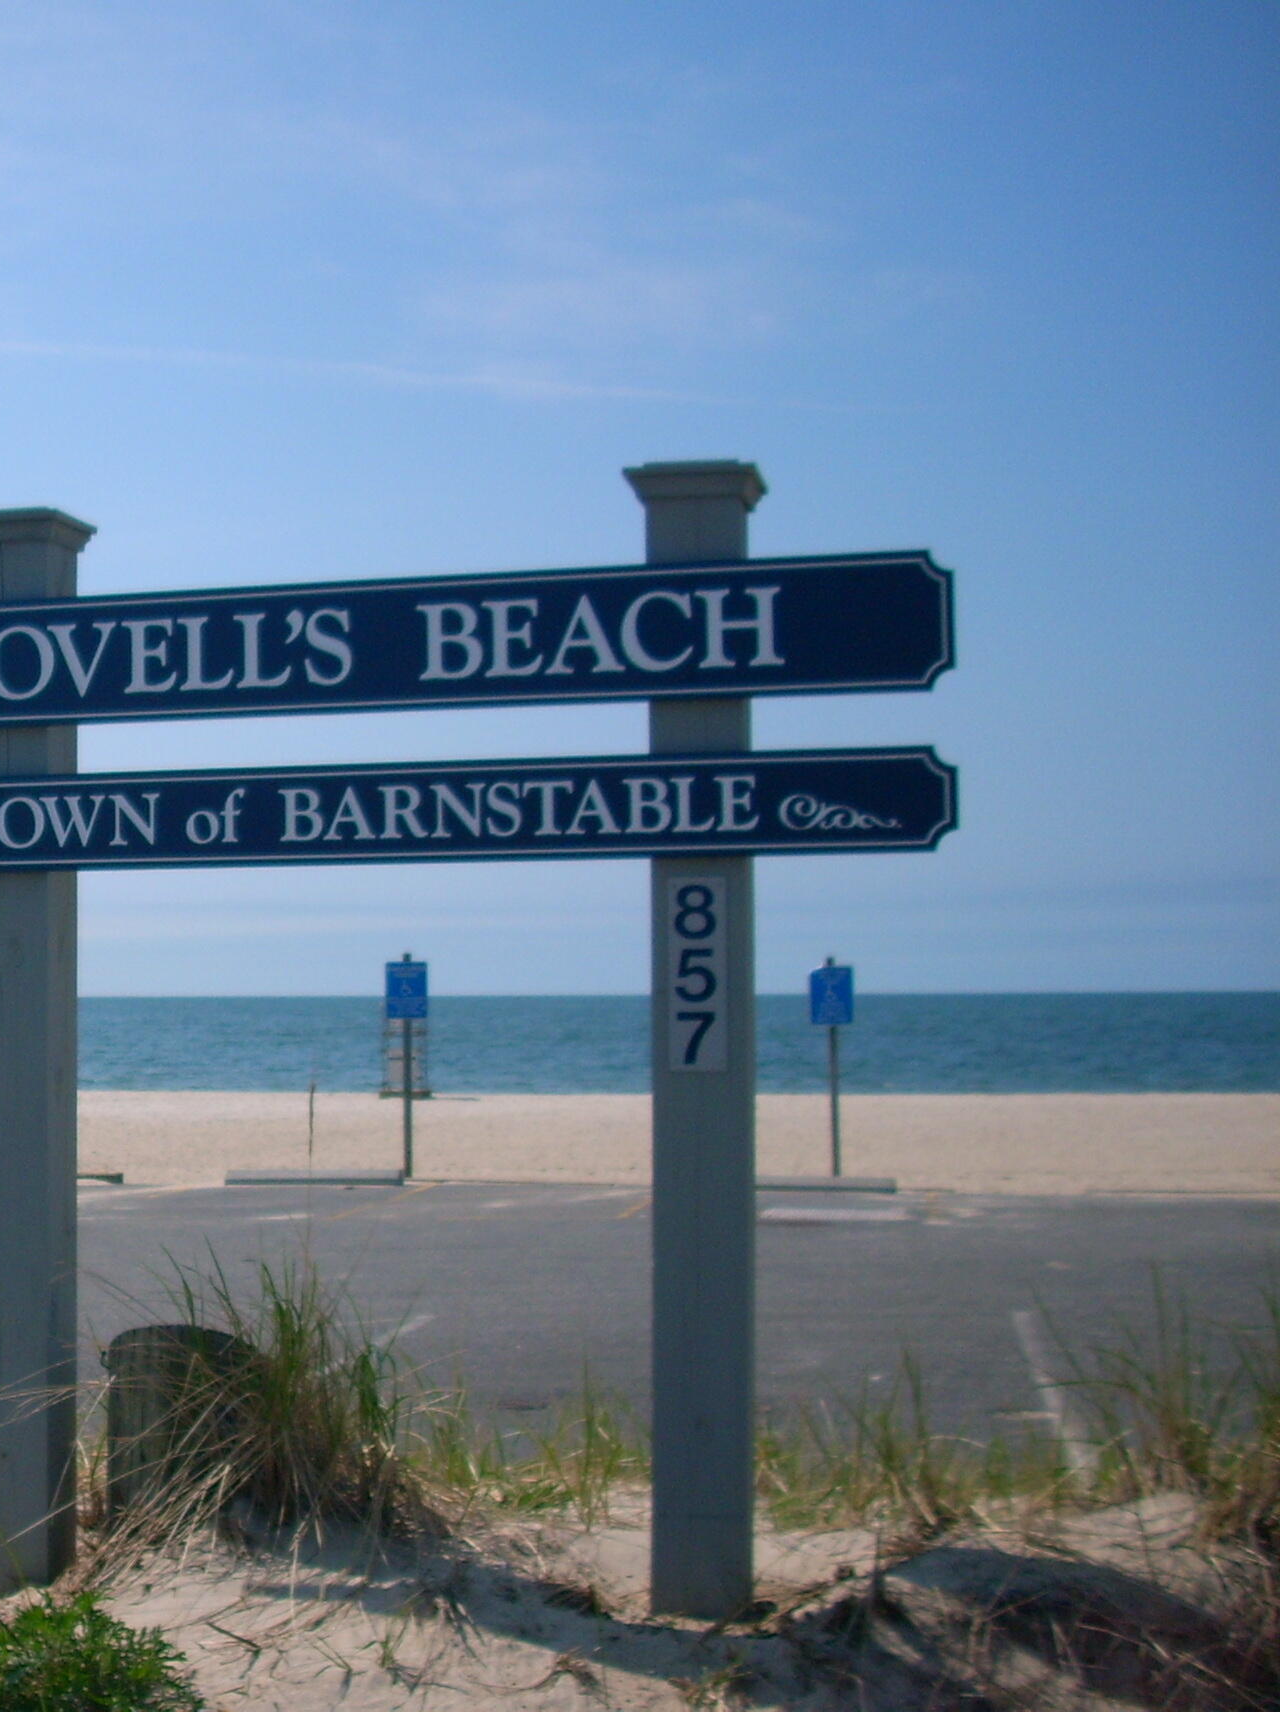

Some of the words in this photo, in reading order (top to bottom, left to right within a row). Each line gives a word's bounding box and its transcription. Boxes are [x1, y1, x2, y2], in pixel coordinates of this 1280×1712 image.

[415, 585, 786, 682] BEACH
[185, 787, 246, 844] of
[278, 775, 760, 844] BARNSTABLE
[675, 884, 717, 1065] 857
